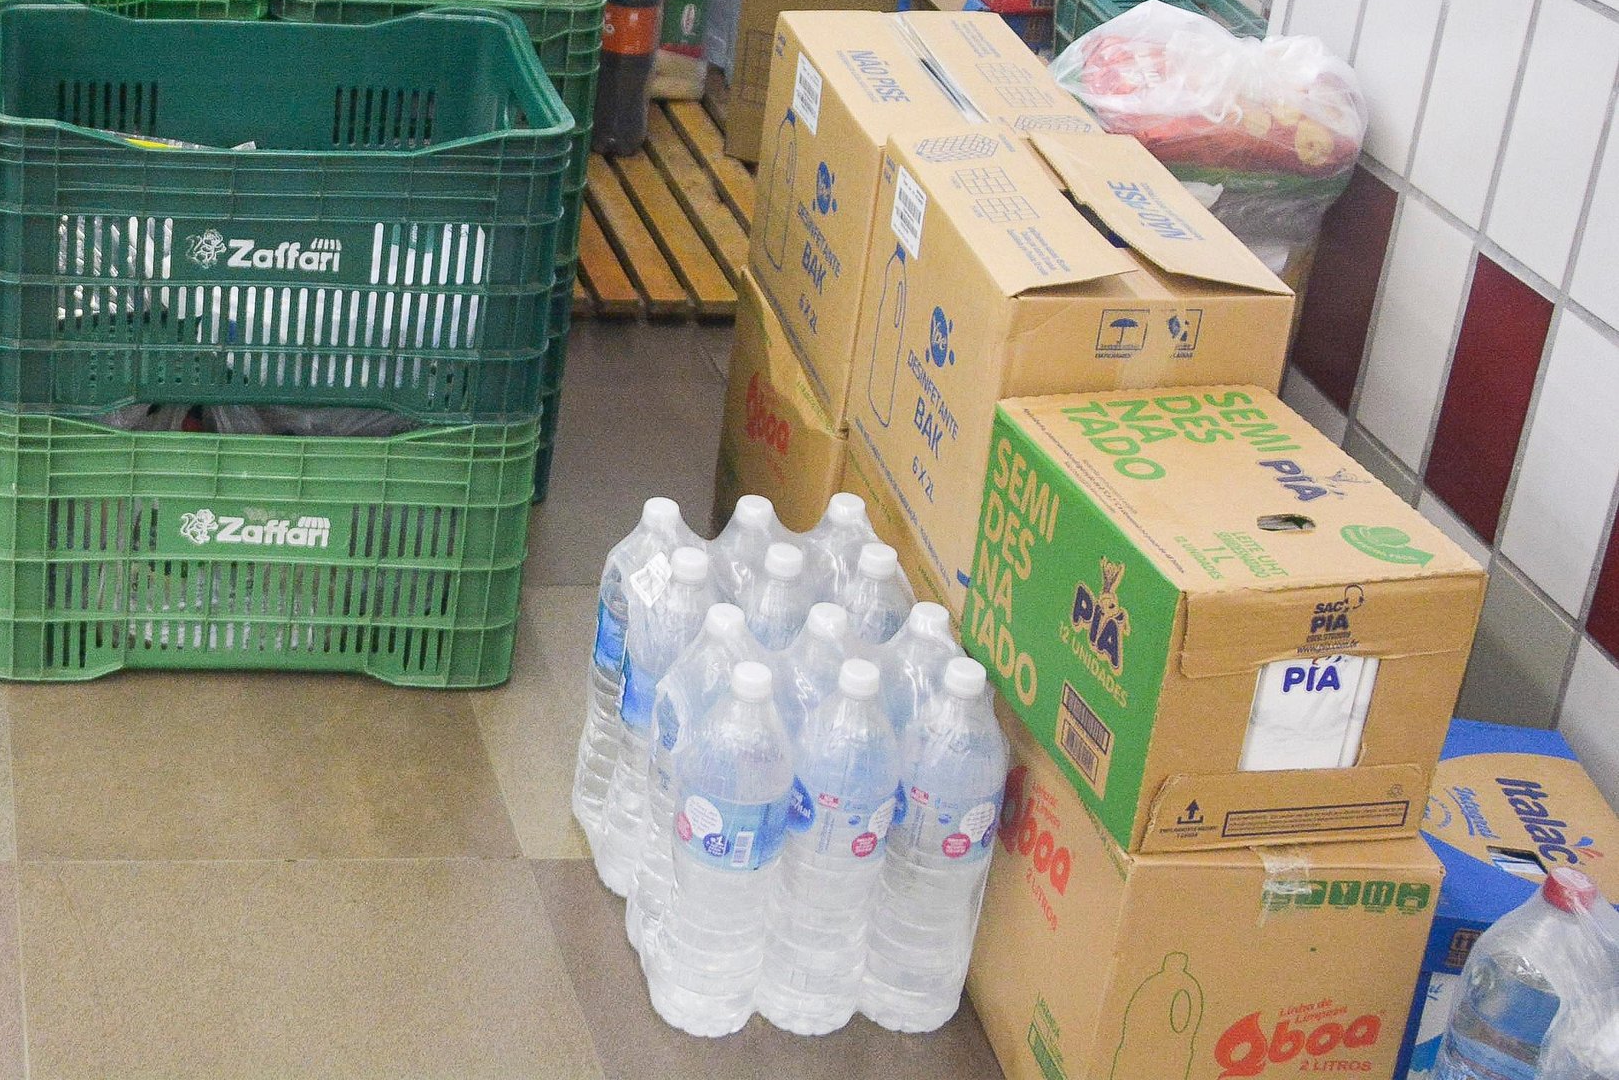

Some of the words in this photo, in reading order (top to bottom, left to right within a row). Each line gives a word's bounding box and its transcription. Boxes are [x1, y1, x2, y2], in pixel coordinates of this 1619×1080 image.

[847, 50, 890, 75] NÃO
[867, 78, 911, 102] PISE
[1107, 180, 1161, 212] PISE
[1138, 212, 1194, 240] NÃO
[227, 239, 342, 272] Zaffari
[802, 240, 827, 296] BAK
[906, 349, 959, 440] DESINFETANTE
[1153, 395, 1234, 444] DES
[914, 395, 944, 461] BAK
[1062, 401, 1167, 481] TADO
[1106, 399, 1178, 444] NA
[1204, 391, 1302, 452] SEMI
[912, 455, 920, 474] 6
[993, 439, 1060, 544] SEMI
[217, 516, 331, 548] Zaffari
[984, 490, 1035, 580] DES
[977, 540, 1013, 624] NA
[1314, 602, 1344, 614] SAC
[970, 587, 1038, 707] TADO
[1071, 636, 1129, 708] UNIDADES
[1496, 777, 1578, 865] Italac
[1295, 1005, 1348, 1024] Limpeza
[1214, 1011, 1383, 1080] Qboa
[1299, 1060, 1308, 1071] 2
[1313, 1060, 1373, 1071] LITROS
